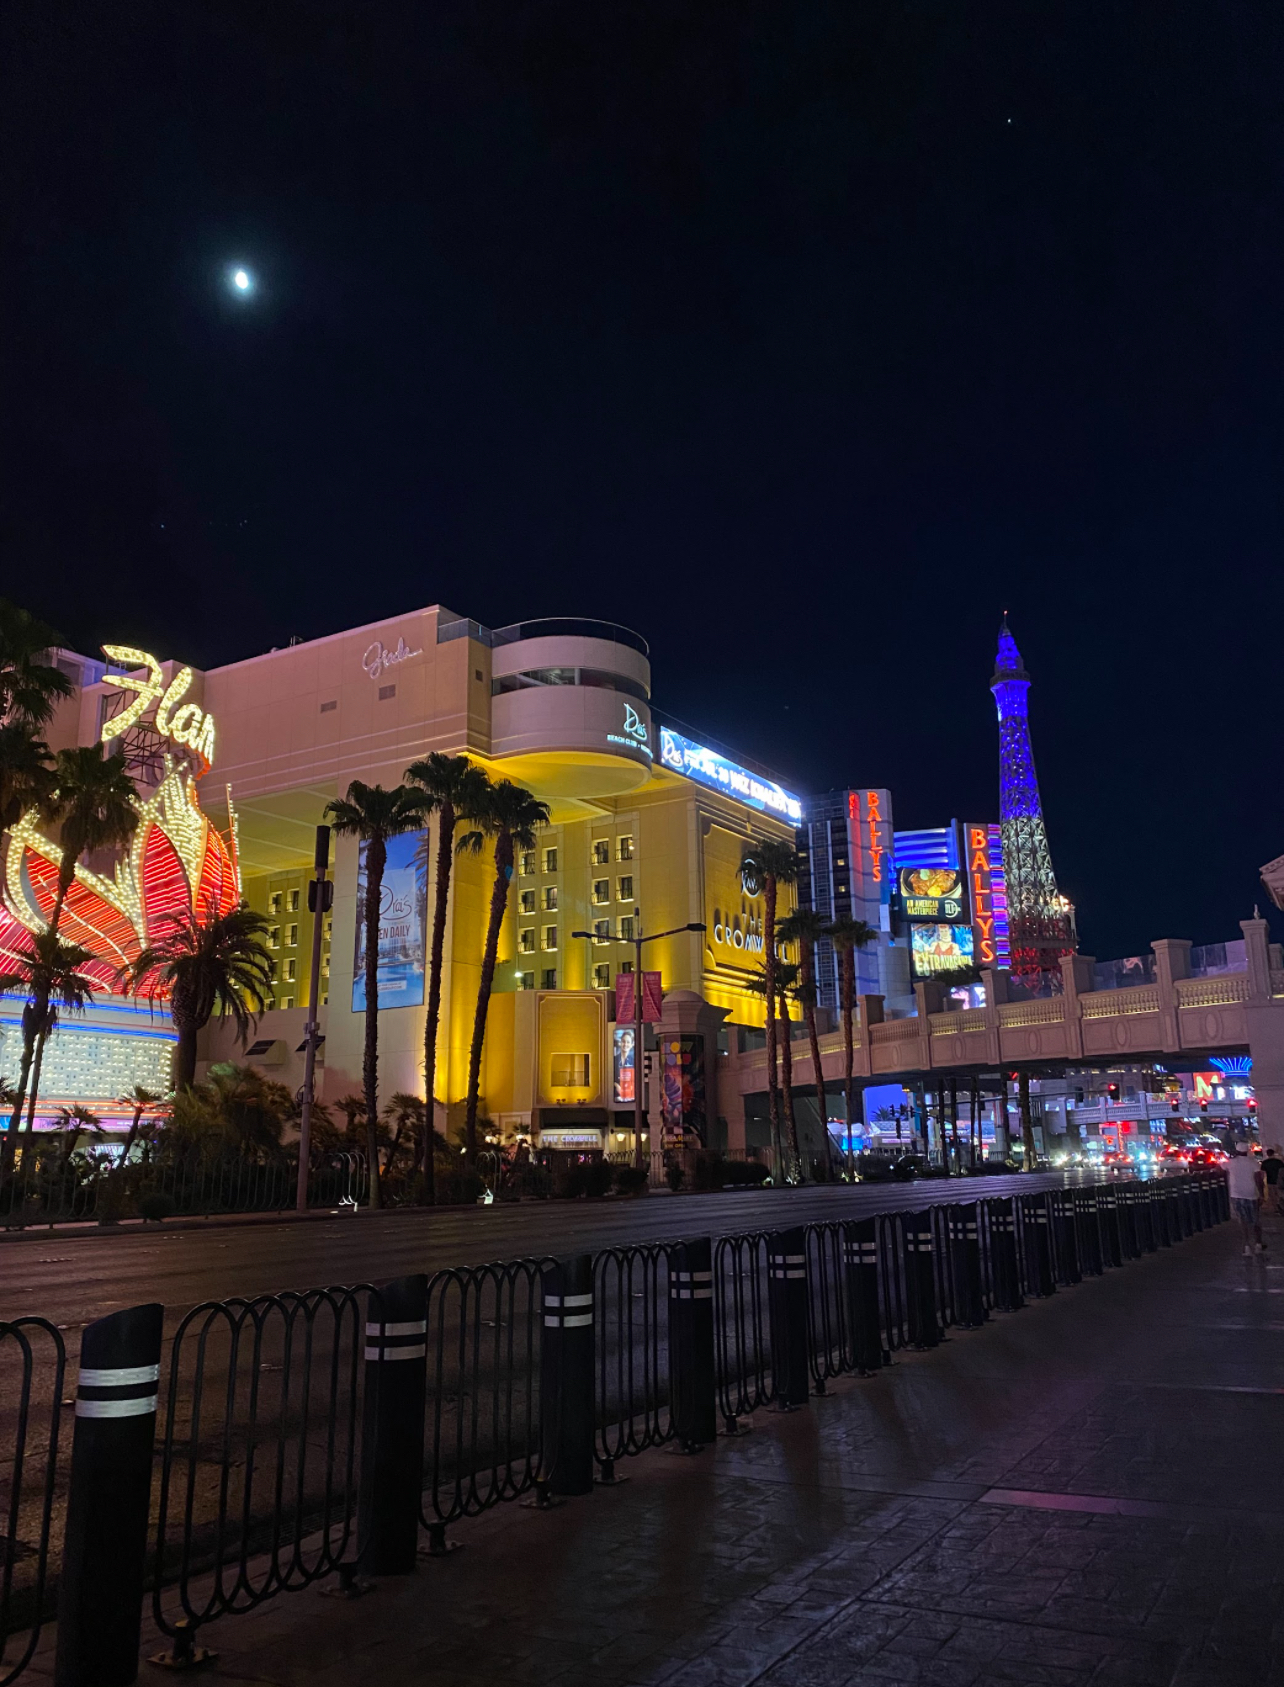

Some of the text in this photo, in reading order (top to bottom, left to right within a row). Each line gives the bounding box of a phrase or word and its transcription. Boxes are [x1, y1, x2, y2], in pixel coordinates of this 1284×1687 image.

[742, 913, 762, 931] THE
[377, 925, 411, 940] EN DAILY
[714, 924, 789, 962] CROMWLL
